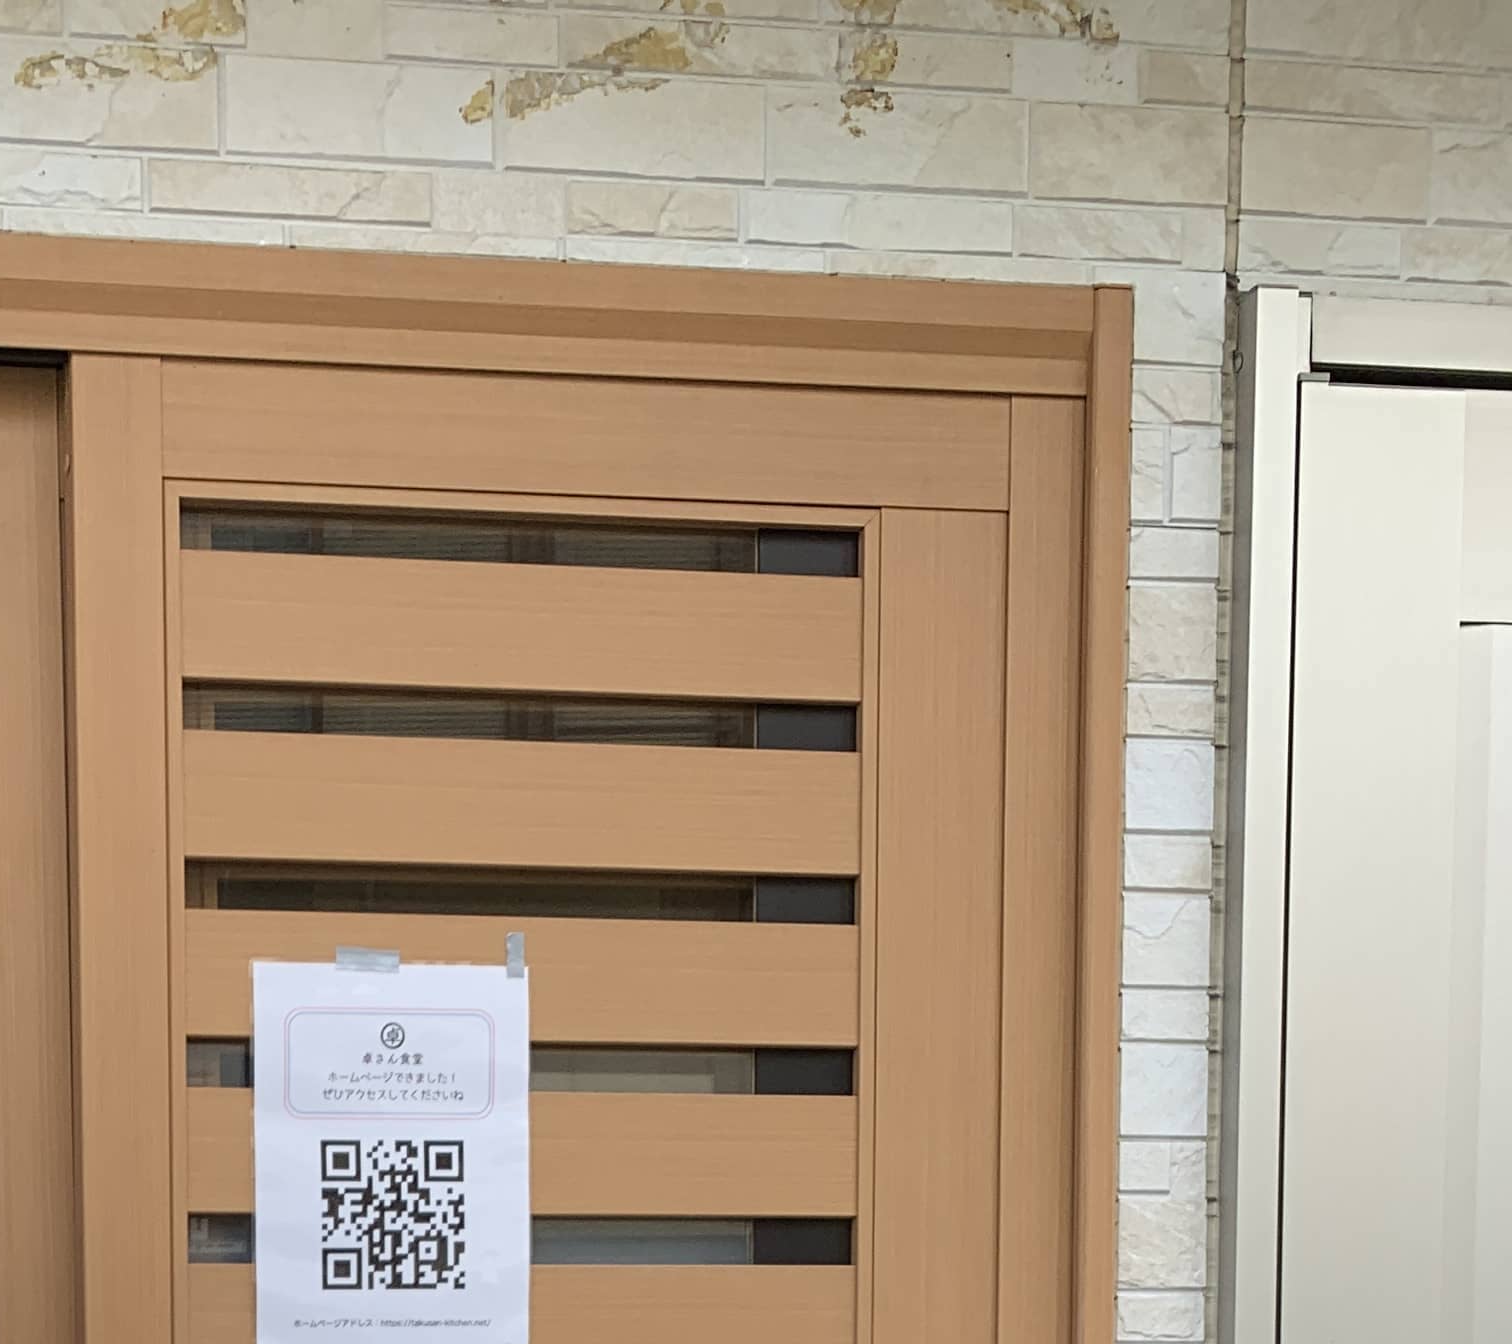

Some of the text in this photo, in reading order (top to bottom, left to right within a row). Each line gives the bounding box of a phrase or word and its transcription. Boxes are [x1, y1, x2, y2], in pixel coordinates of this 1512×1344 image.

[361, 1052, 424, 1065] 卓さん食堂
[322, 1088, 465, 1101] ぜひアクセスしてくださいね
